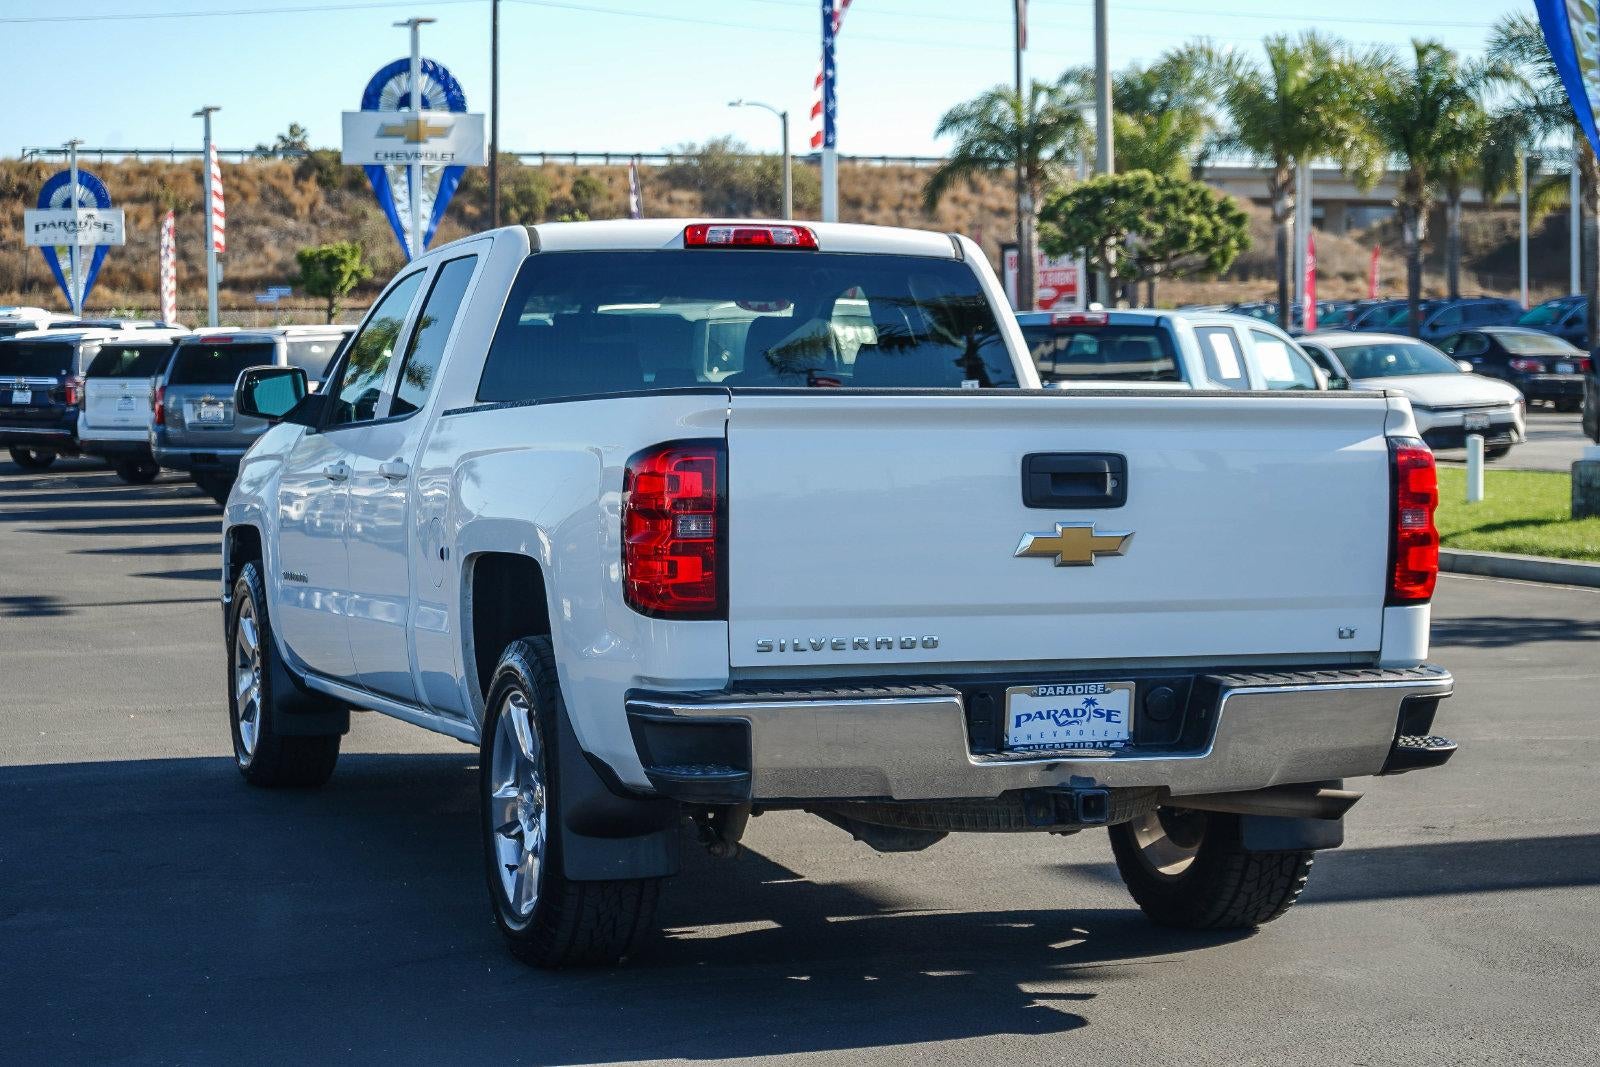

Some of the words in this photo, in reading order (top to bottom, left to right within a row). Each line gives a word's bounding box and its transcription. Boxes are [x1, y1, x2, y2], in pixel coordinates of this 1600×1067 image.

[34, 213, 115, 234] PARADISE
[756, 634, 940, 653] SILVERADO
[1038, 684, 1105, 696] PARADISE
[1014, 697, 1122, 729] PARADISE
[1014, 729, 1121, 743] CHEVROLET
